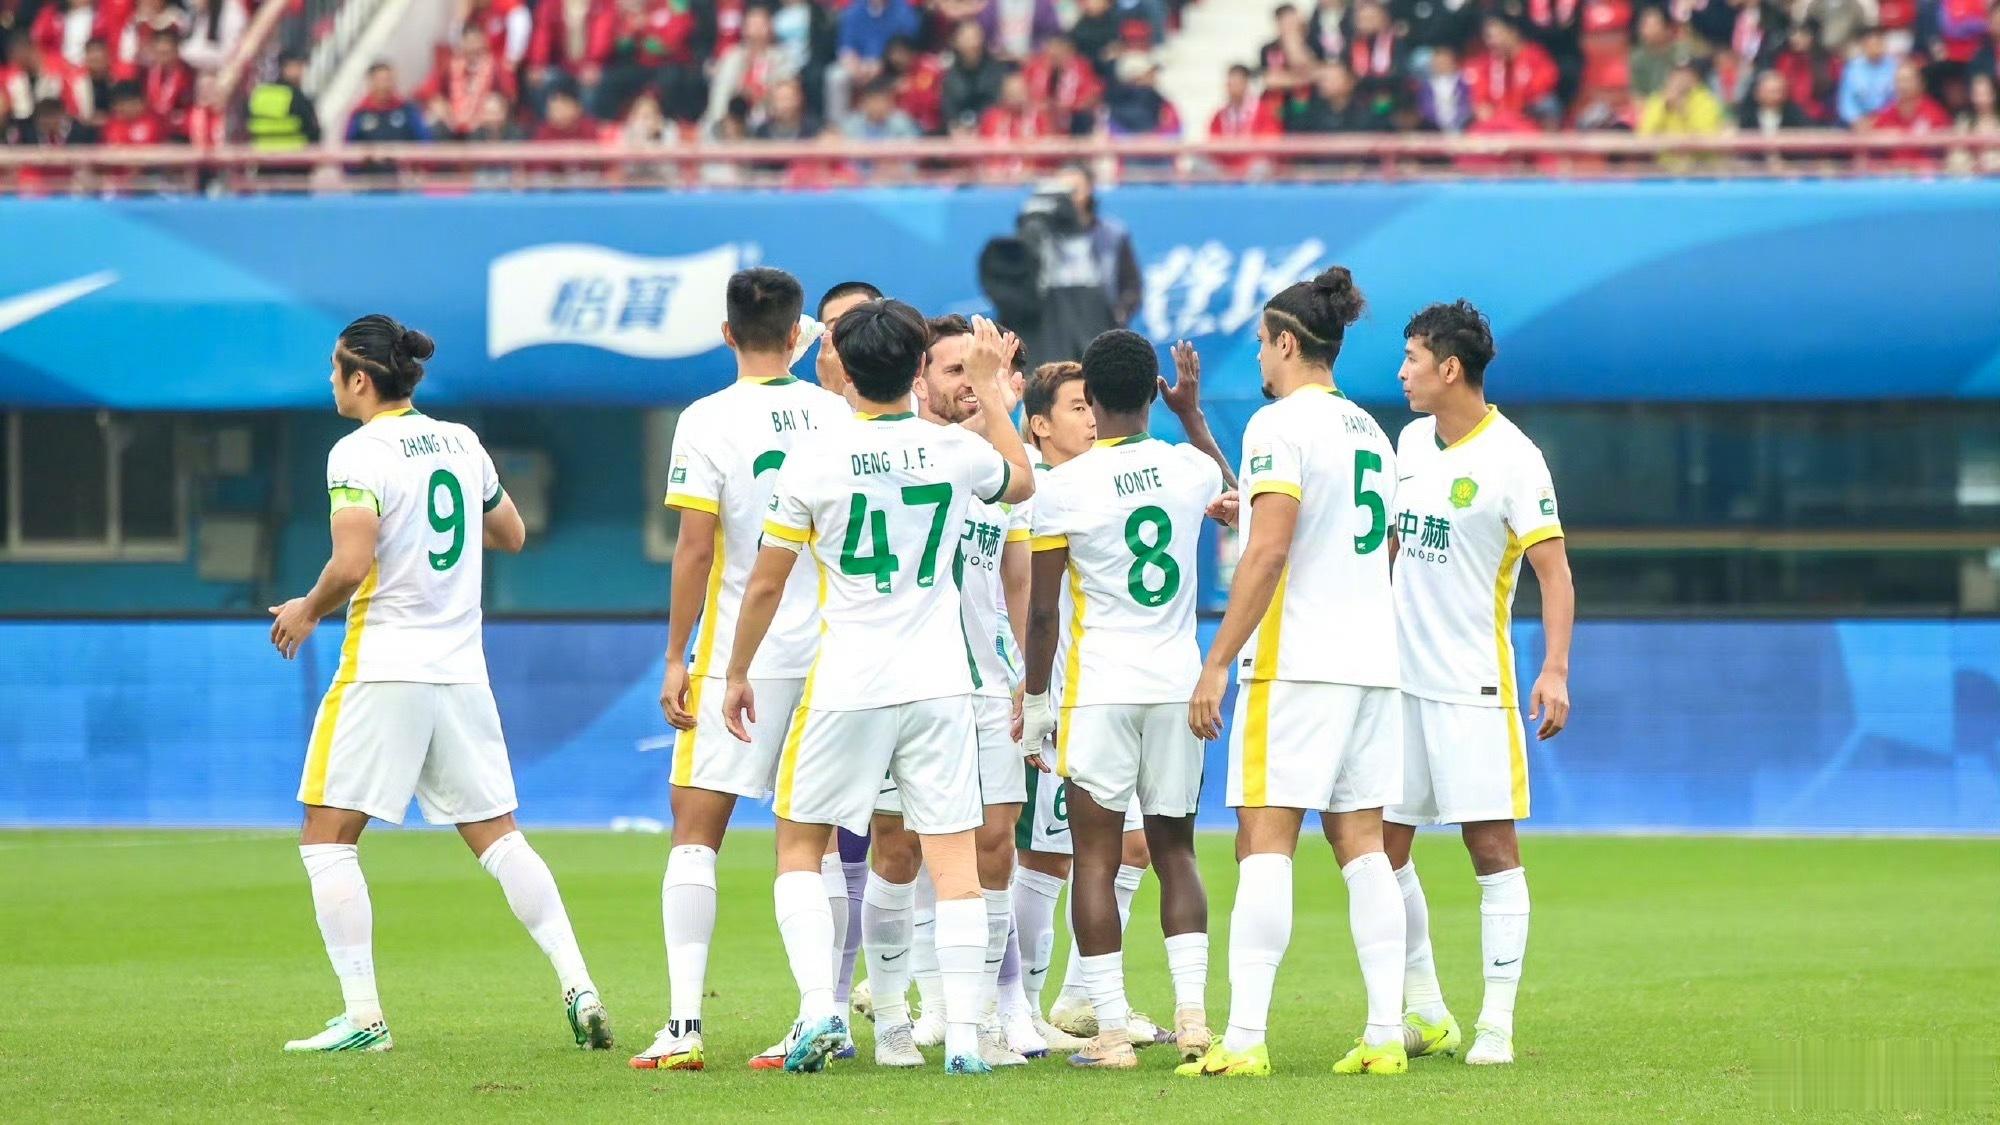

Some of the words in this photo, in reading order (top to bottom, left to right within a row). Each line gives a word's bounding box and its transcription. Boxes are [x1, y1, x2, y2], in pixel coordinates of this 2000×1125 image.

[771, 408, 797, 433] BAI
[802, 410, 819, 431] Y.
[400, 433, 441, 458] ZHANG
[851, 451, 891, 476] DENG
[1113, 466, 1163, 497] KONTE
[1353, 449, 1387, 555] 5
[427, 469, 465, 572] 9
[839, 481, 954, 594] 47
[1398, 508, 1451, 551] 中赫
[1124, 505, 1181, 608] 8
